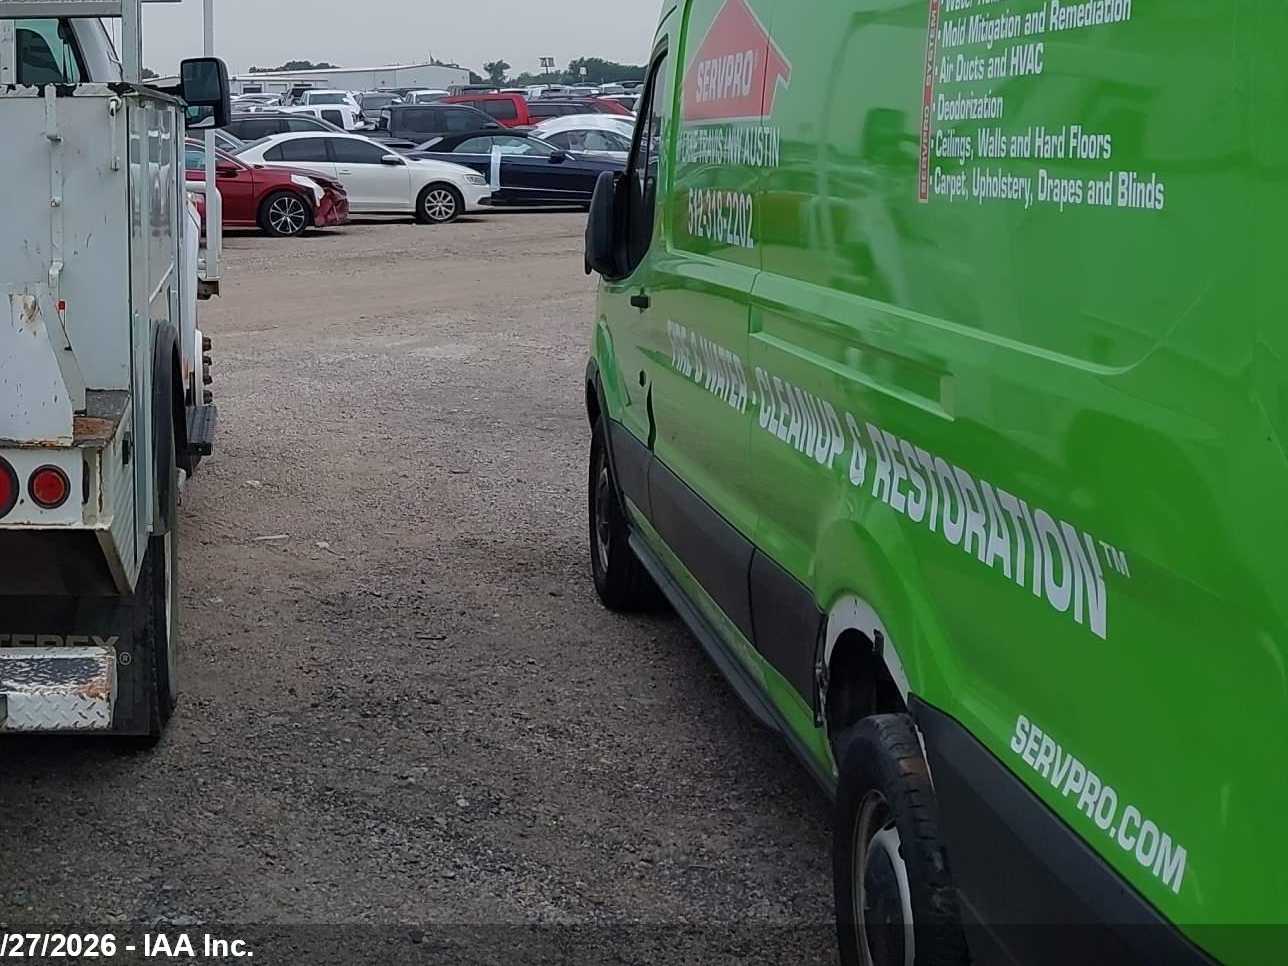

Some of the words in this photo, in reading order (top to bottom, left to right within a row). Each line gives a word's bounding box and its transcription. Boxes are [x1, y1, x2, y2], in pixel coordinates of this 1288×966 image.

[942, 17, 966, 48] Mold
[968, 9, 1020, 49] Mitigation
[1025, 2, 1046, 35] and
[695, 50, 754, 103] SERVPRO
[939, 55, 954, 84] Air
[956, 53, 984, 82] Ducts
[987, 48, 1007, 78] and
[1010, 42, 1044, 77] HVAC
[937, 90, 1003, 121] Deodorization
[743, 125, 780, 168] AUSTIN
[935, 128, 974, 165] Ceilings,
[978, 127, 1007, 157] Walls
[1011, 127, 1031, 158] and
[1035, 126, 1066, 159] Hard
[1069, 125, 1112, 160] Floors
[934, 167, 969, 202] Carpet,
[972, 167, 1033, 209] Upholstery,
[1037, 169, 1083, 212] Drapes
[1087, 171, 1112, 206] and
[1117, 171, 1165, 210] Blinds
[688, 187, 754, 250] 512-318-2202
[700, 336, 747, 414] WATER
[755, 366, 845, 469] CLEANUP
[845, 411, 867, 487] &
[866, 422, 1107, 640] RESTORATION
[1010, 715, 1188, 895] SERVPRO.COM
